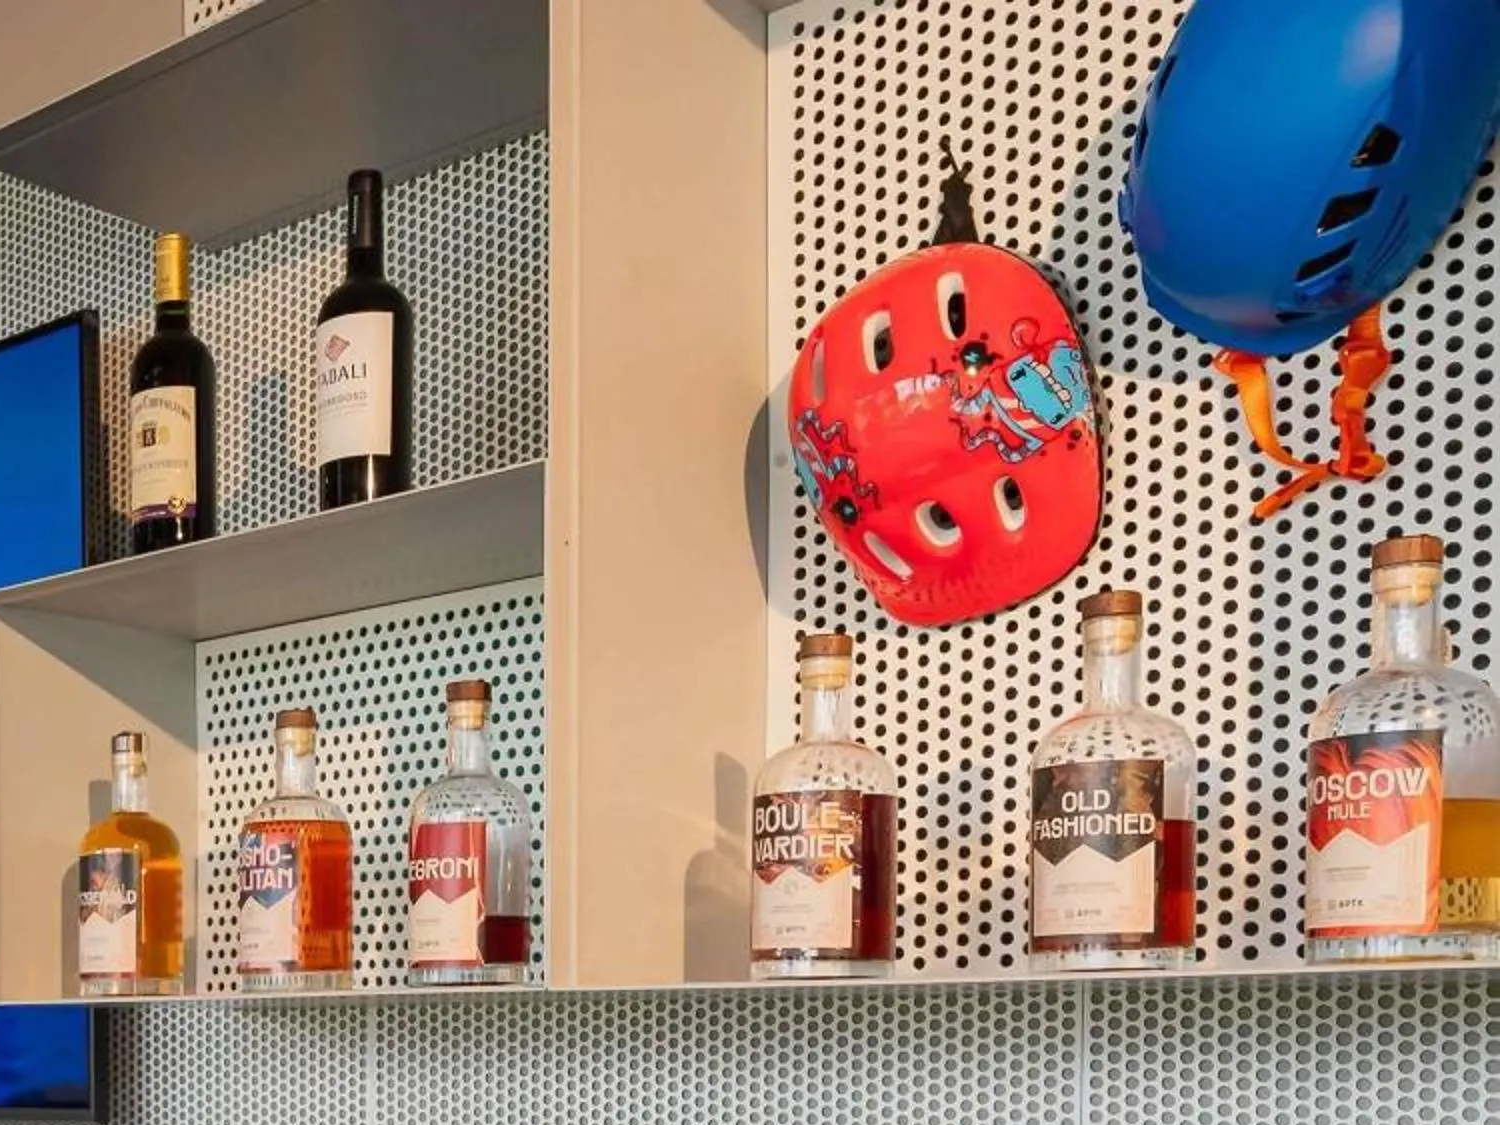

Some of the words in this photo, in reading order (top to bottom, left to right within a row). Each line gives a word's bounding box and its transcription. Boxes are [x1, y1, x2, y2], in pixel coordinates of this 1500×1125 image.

[1309, 767, 1432, 805] OSCOW
[1061, 788, 1111, 813] OLD
[1327, 801, 1373, 821] MULE
[755, 801, 854, 834] BOULE-
[1033, 813, 1157, 841] FASHIONED
[755, 833, 855, 862] VARDIER
[409, 856, 479, 881] EGRONI
